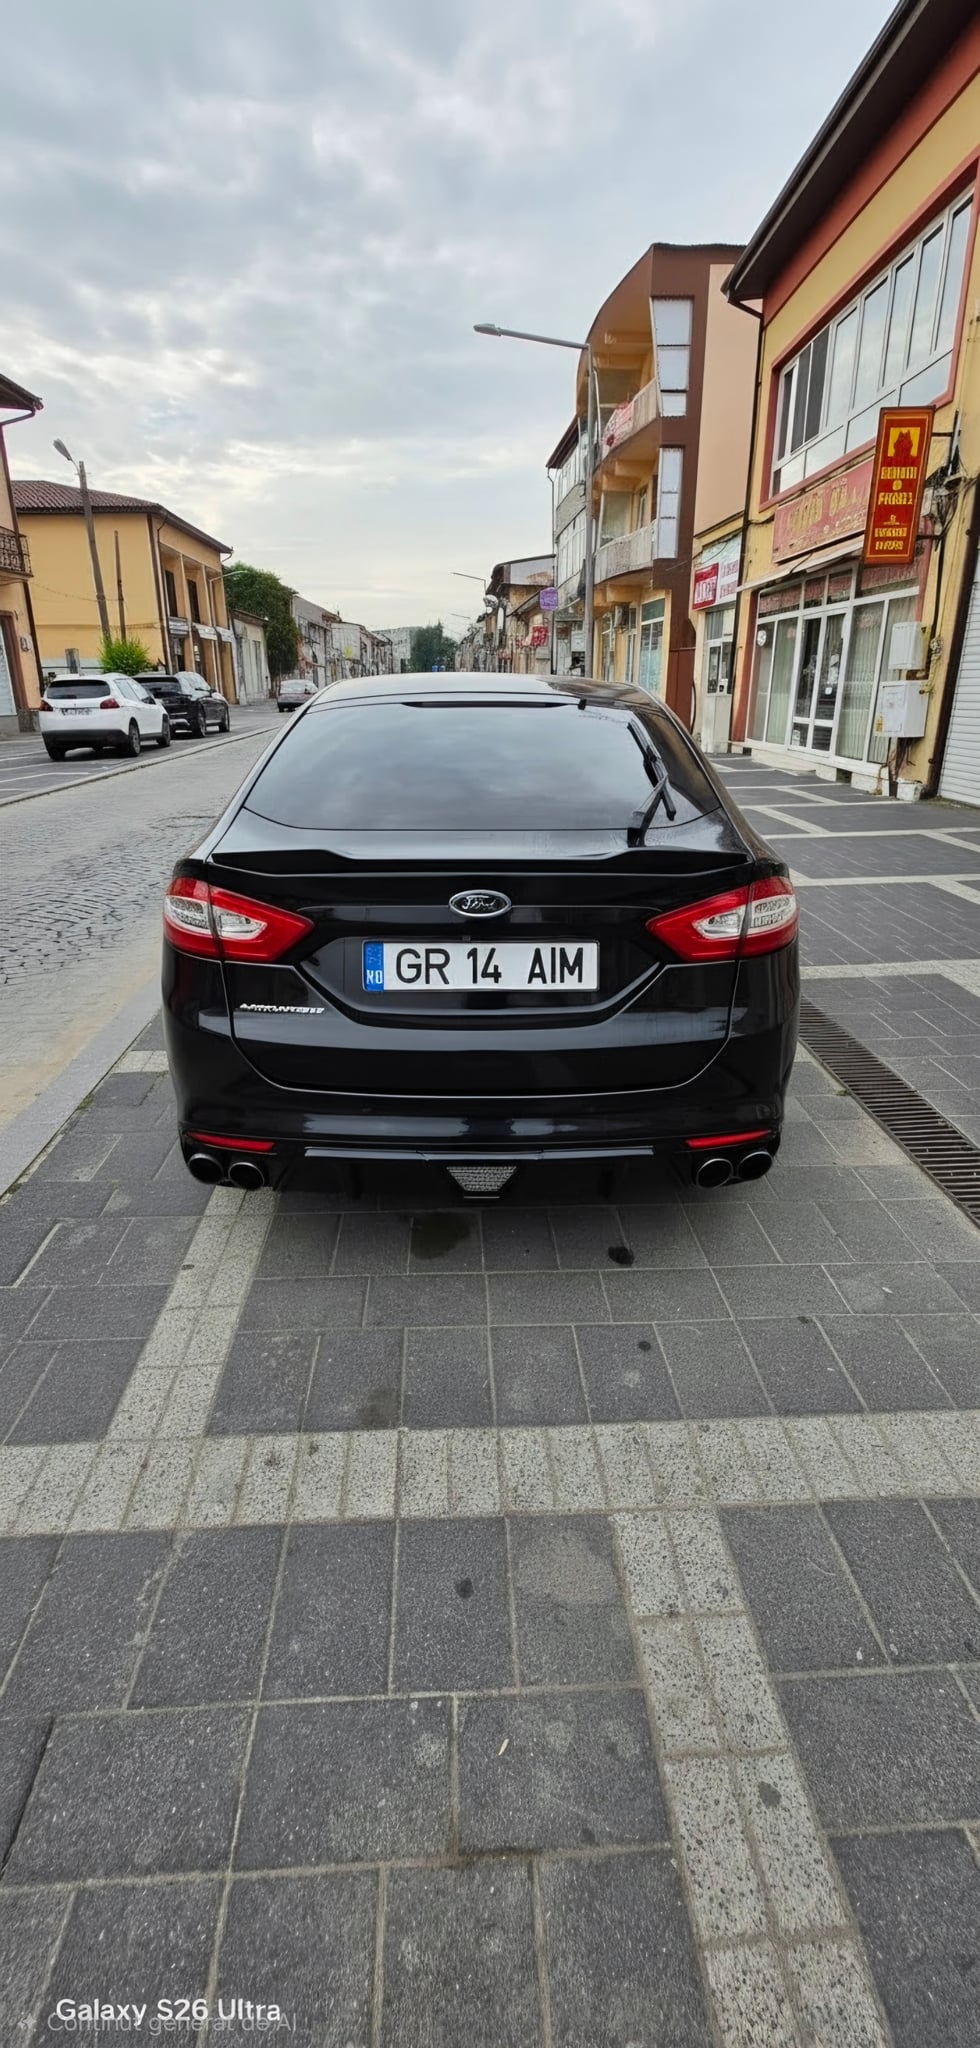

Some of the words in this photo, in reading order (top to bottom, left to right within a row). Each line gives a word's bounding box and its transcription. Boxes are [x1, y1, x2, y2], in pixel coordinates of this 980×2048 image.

[396, 948, 450, 985] GR
[467, 947, 502, 984] 14
[527, 947, 583, 984] AIM
